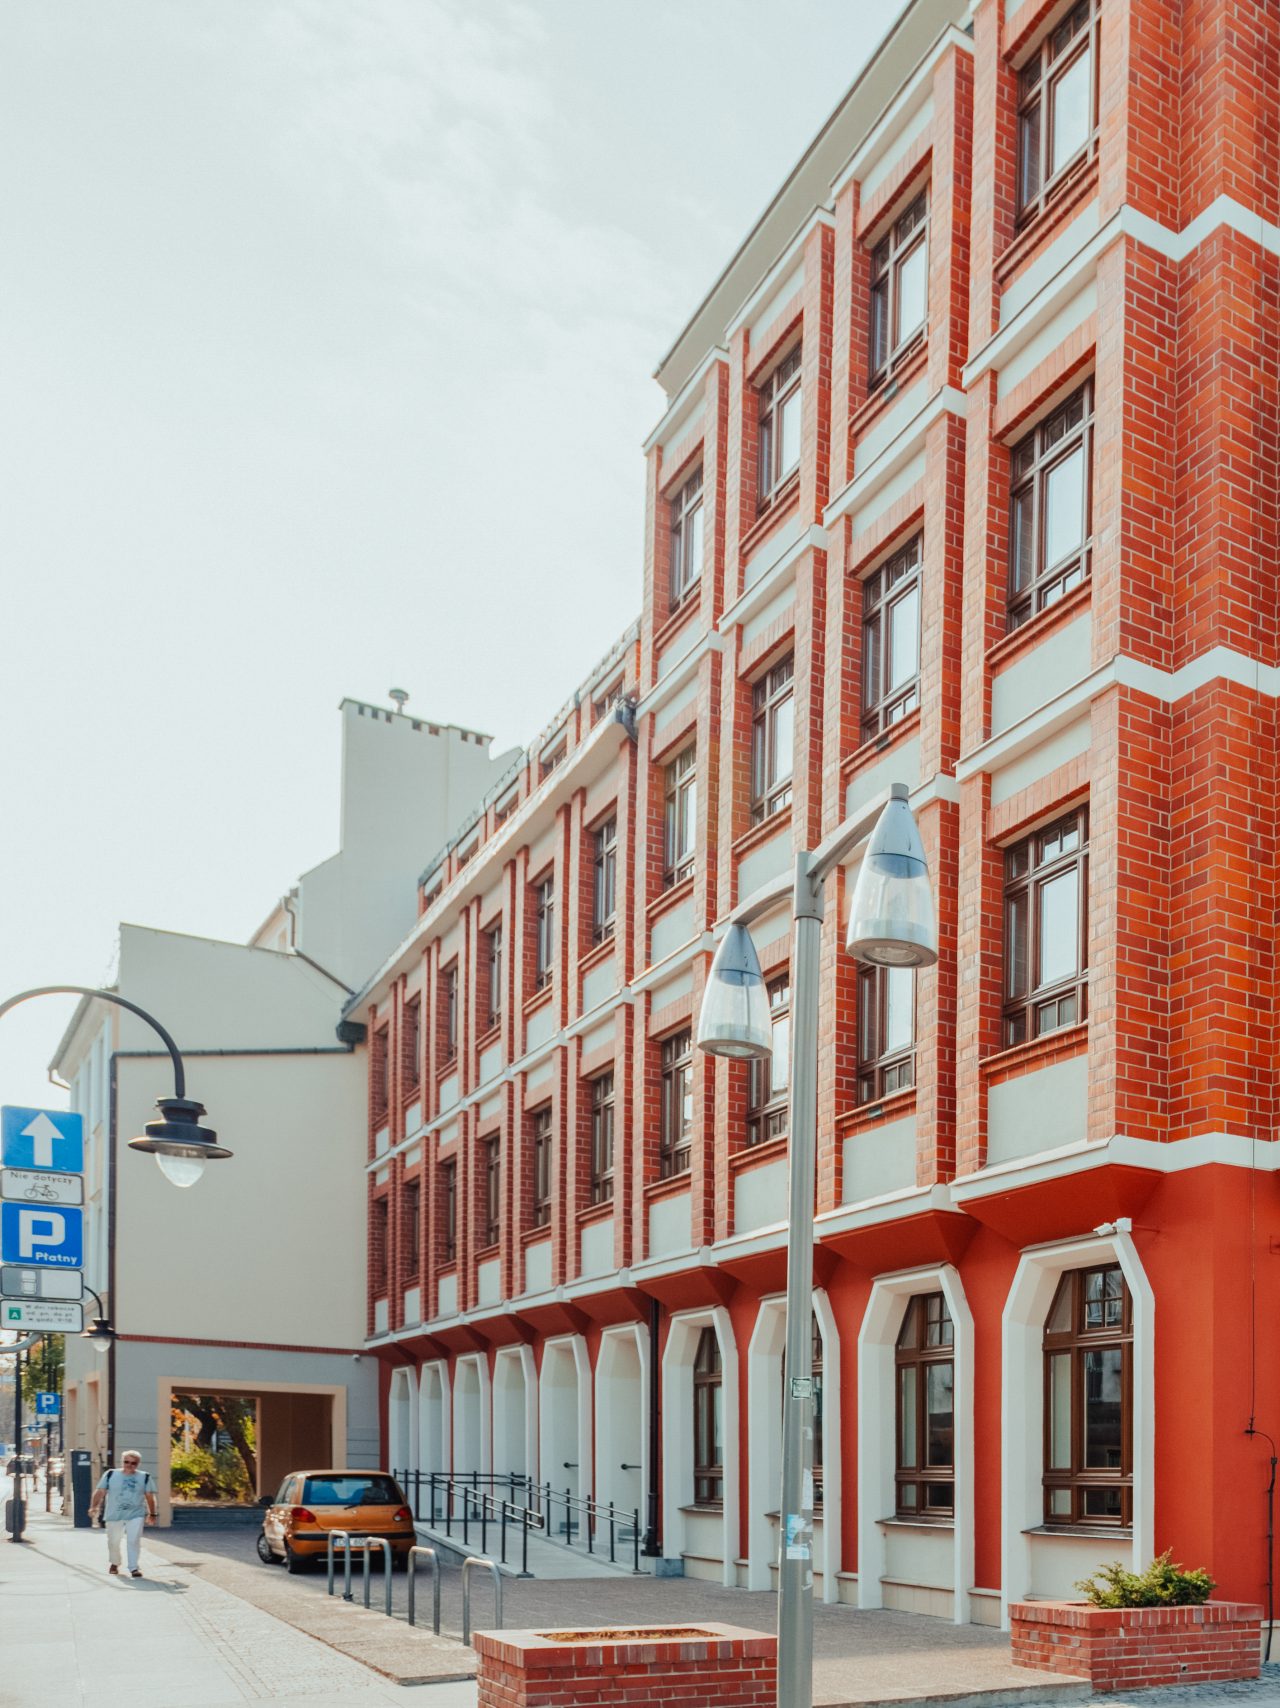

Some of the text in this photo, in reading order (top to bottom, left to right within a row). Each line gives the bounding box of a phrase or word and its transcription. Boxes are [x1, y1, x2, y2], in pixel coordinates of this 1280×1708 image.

[10, 1171, 72, 1184] Nie dotyczy
[19, 1210, 65, 1257] P
[36, 1252, 77, 1265] Płatny
[41, 1395, 55, 1407] P
